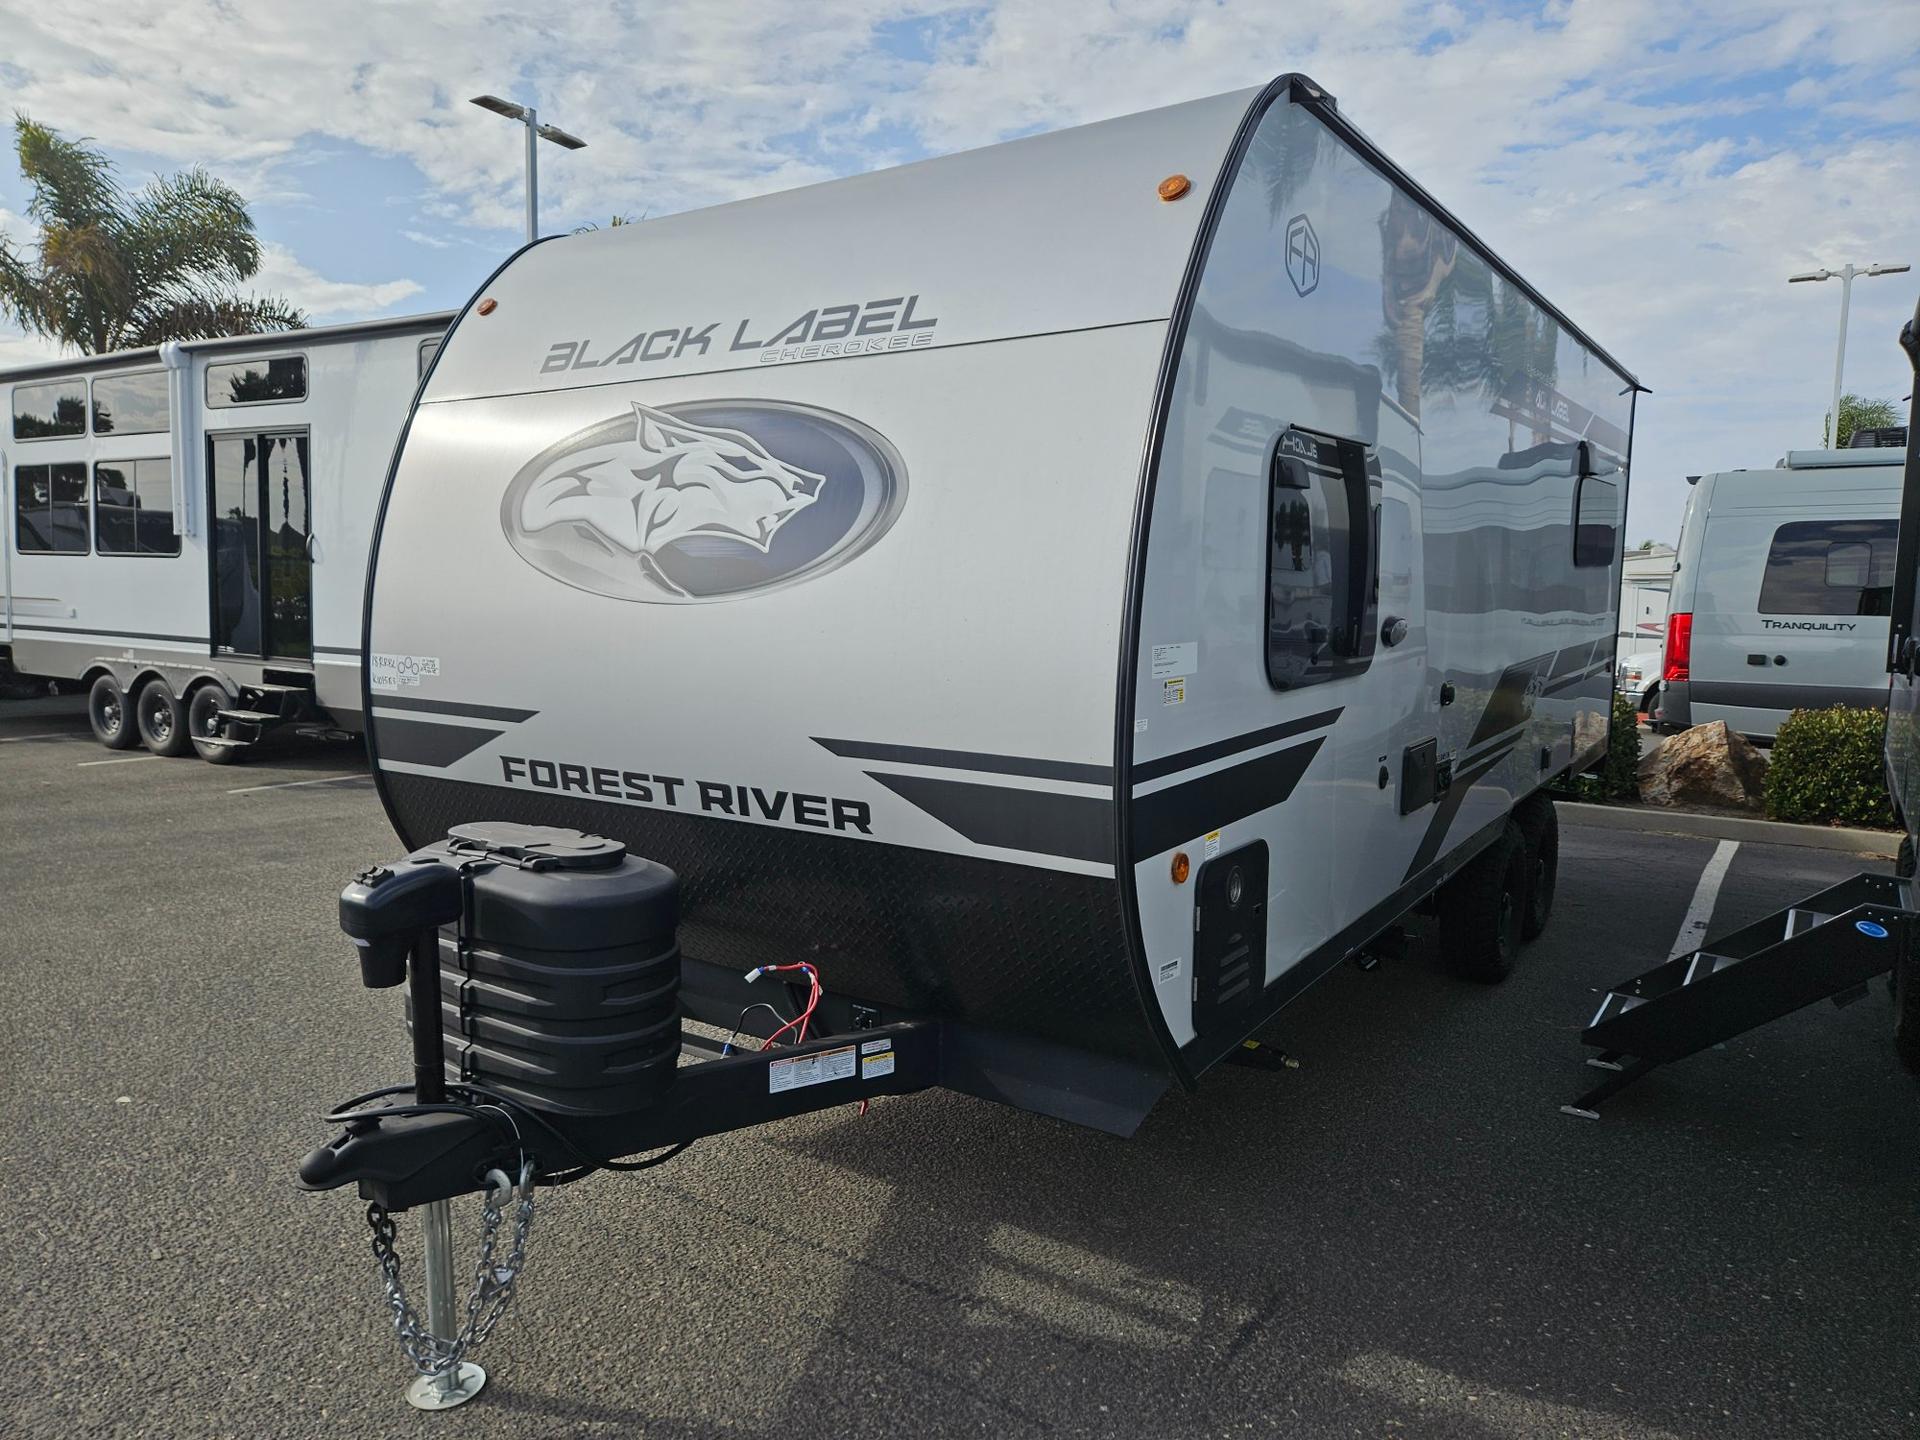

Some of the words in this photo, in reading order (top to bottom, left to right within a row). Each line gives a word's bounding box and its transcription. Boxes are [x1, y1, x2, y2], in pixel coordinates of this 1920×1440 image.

[540, 323, 722, 374] BLACK
[729, 294, 938, 352] LABEL
[760, 331, 935, 363] CHEROKEE
[1761, 619, 1857, 631] TRANQUILITY
[500, 755, 685, 806] FOREST
[696, 780, 873, 836] RIVER
